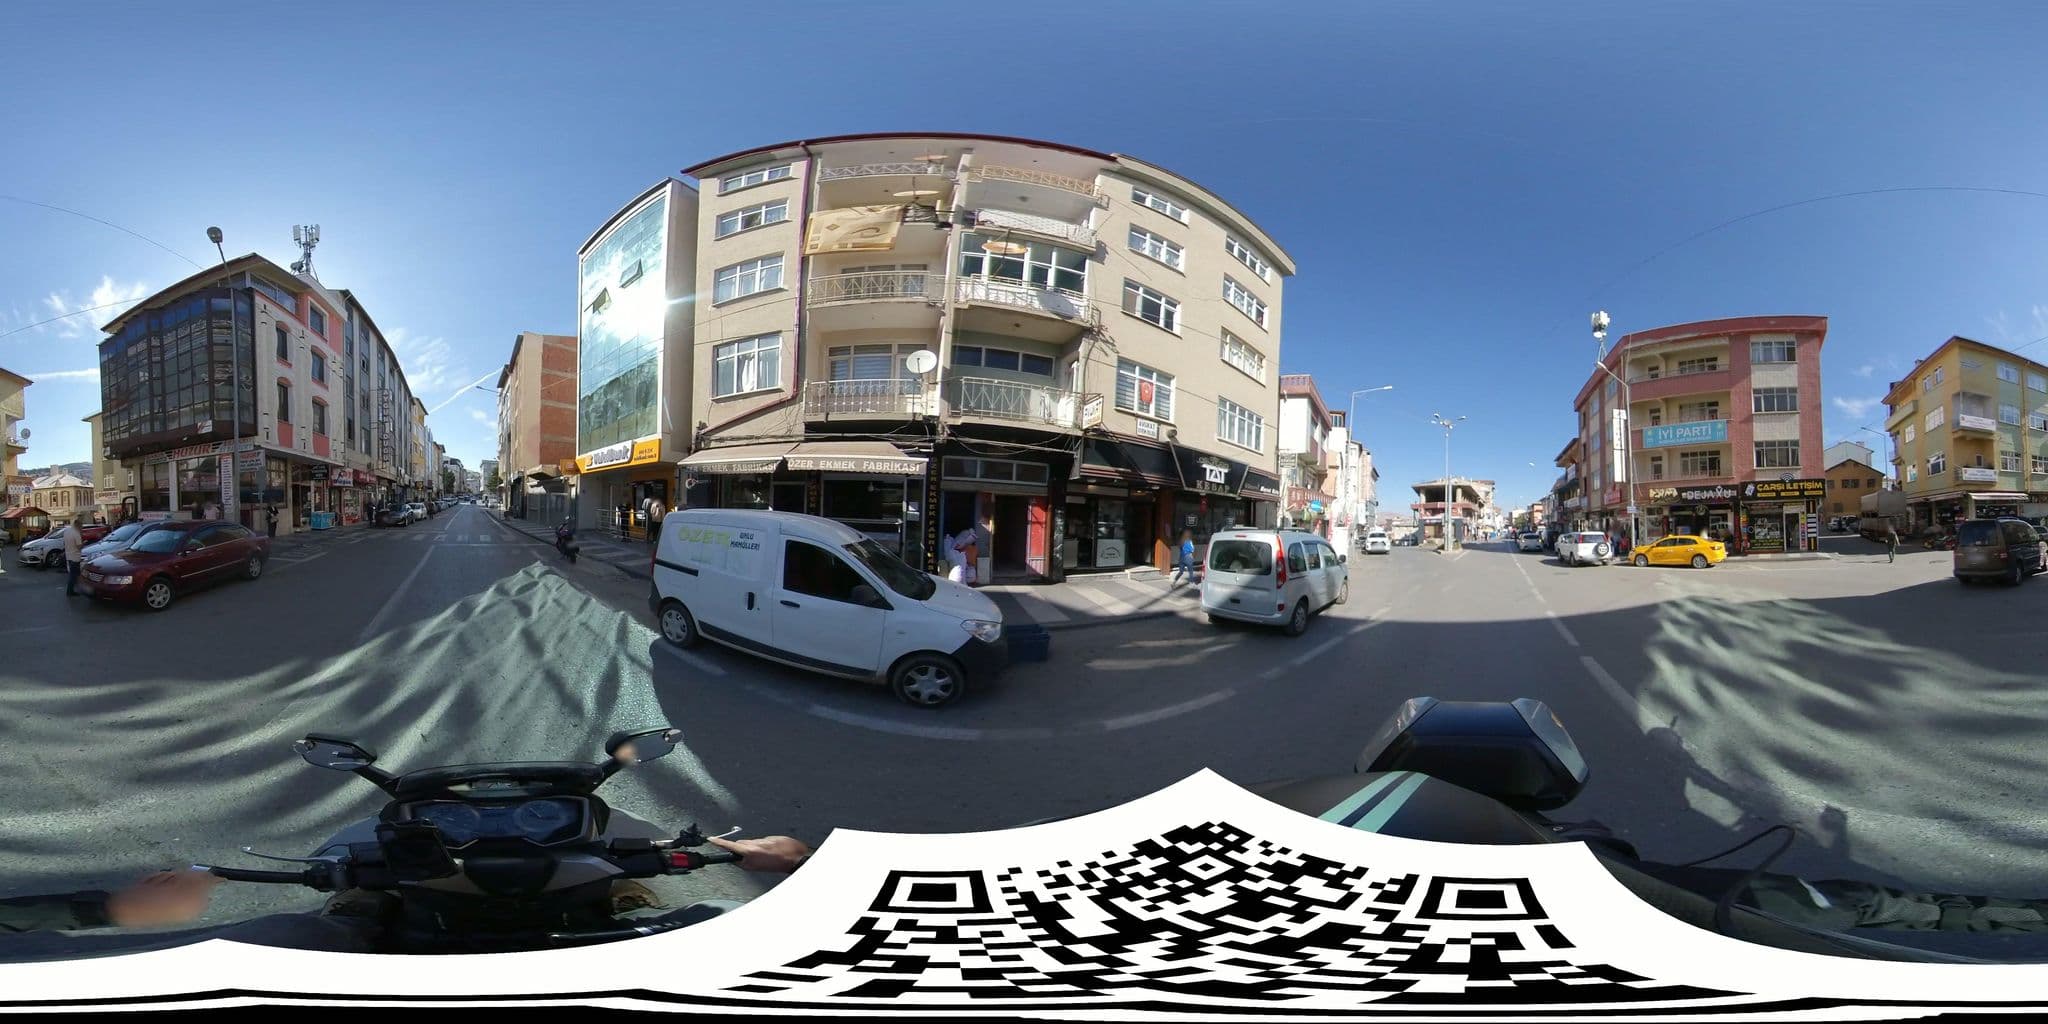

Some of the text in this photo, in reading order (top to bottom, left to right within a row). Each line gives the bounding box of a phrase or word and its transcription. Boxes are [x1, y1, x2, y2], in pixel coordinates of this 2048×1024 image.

[1658, 424, 1711, 439] İYİ PARTİ
[788, 459, 920, 472] ÖZER EKMEK FABRİKASI
[1201, 463, 1229, 484] TAT
[1196, 480, 1230, 494] KEBAP
